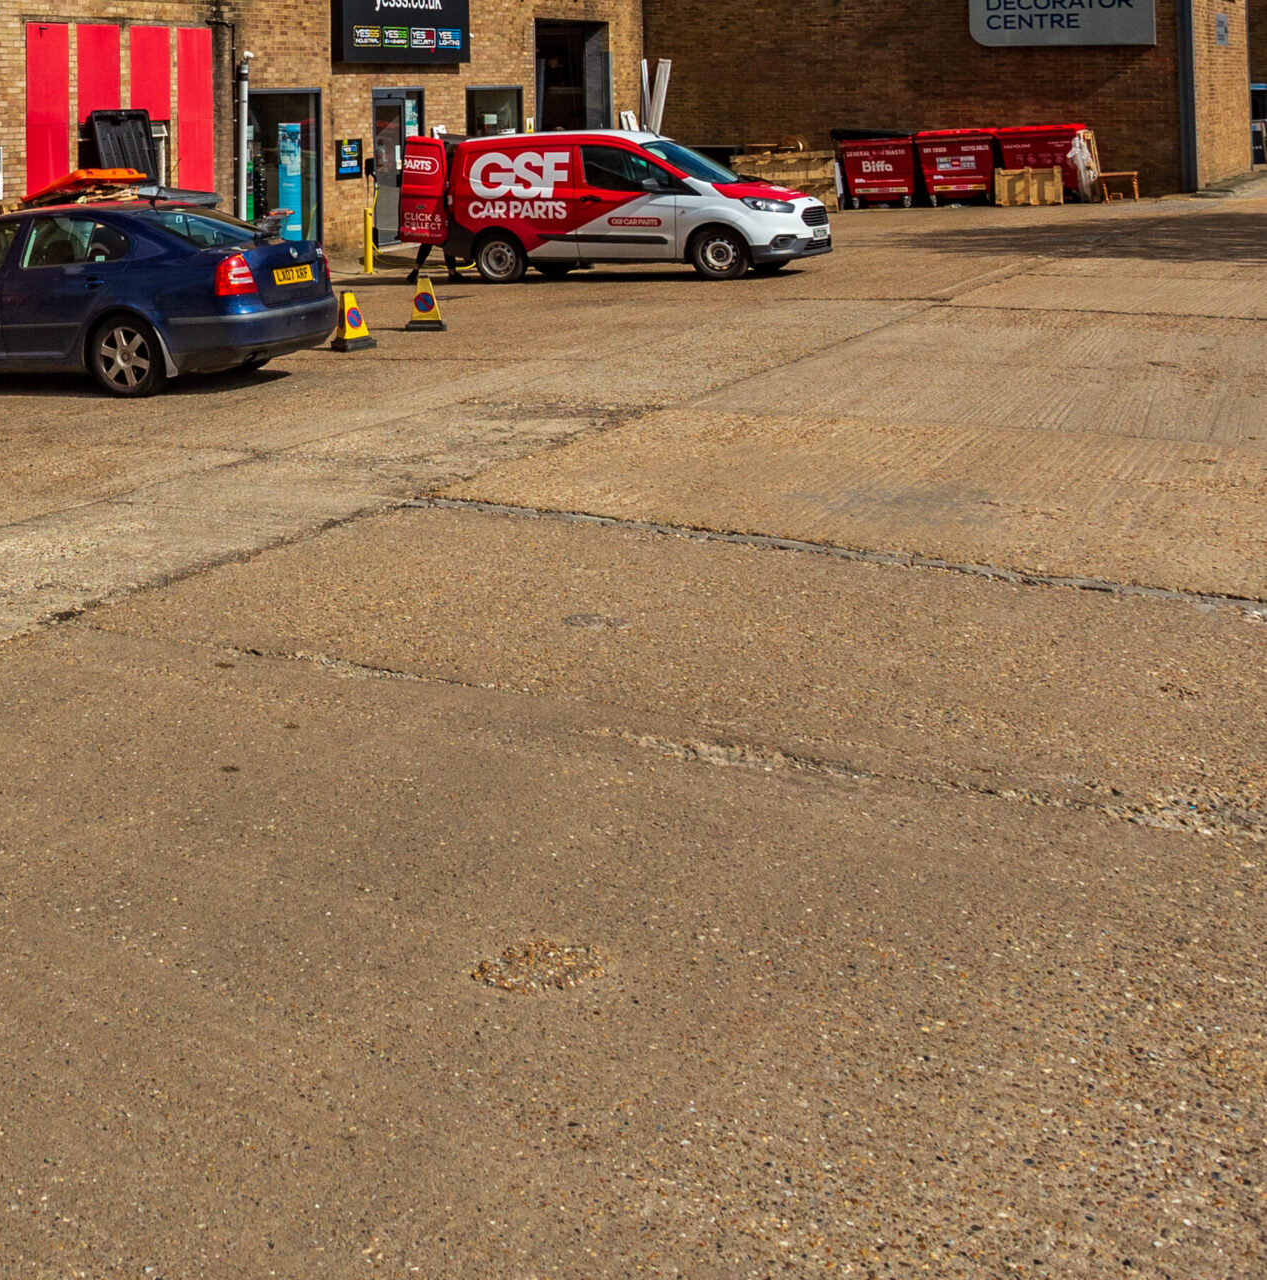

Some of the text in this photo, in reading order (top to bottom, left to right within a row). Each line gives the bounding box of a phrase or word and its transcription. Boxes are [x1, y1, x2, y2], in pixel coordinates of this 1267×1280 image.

[986, 13, 1080, 30] CENTRE
[469, 151, 570, 199] GSF
[862, 160, 893, 173] Biffa
[404, 212, 441, 222] CLICK &
[468, 201, 567, 219] CAR PARTS
